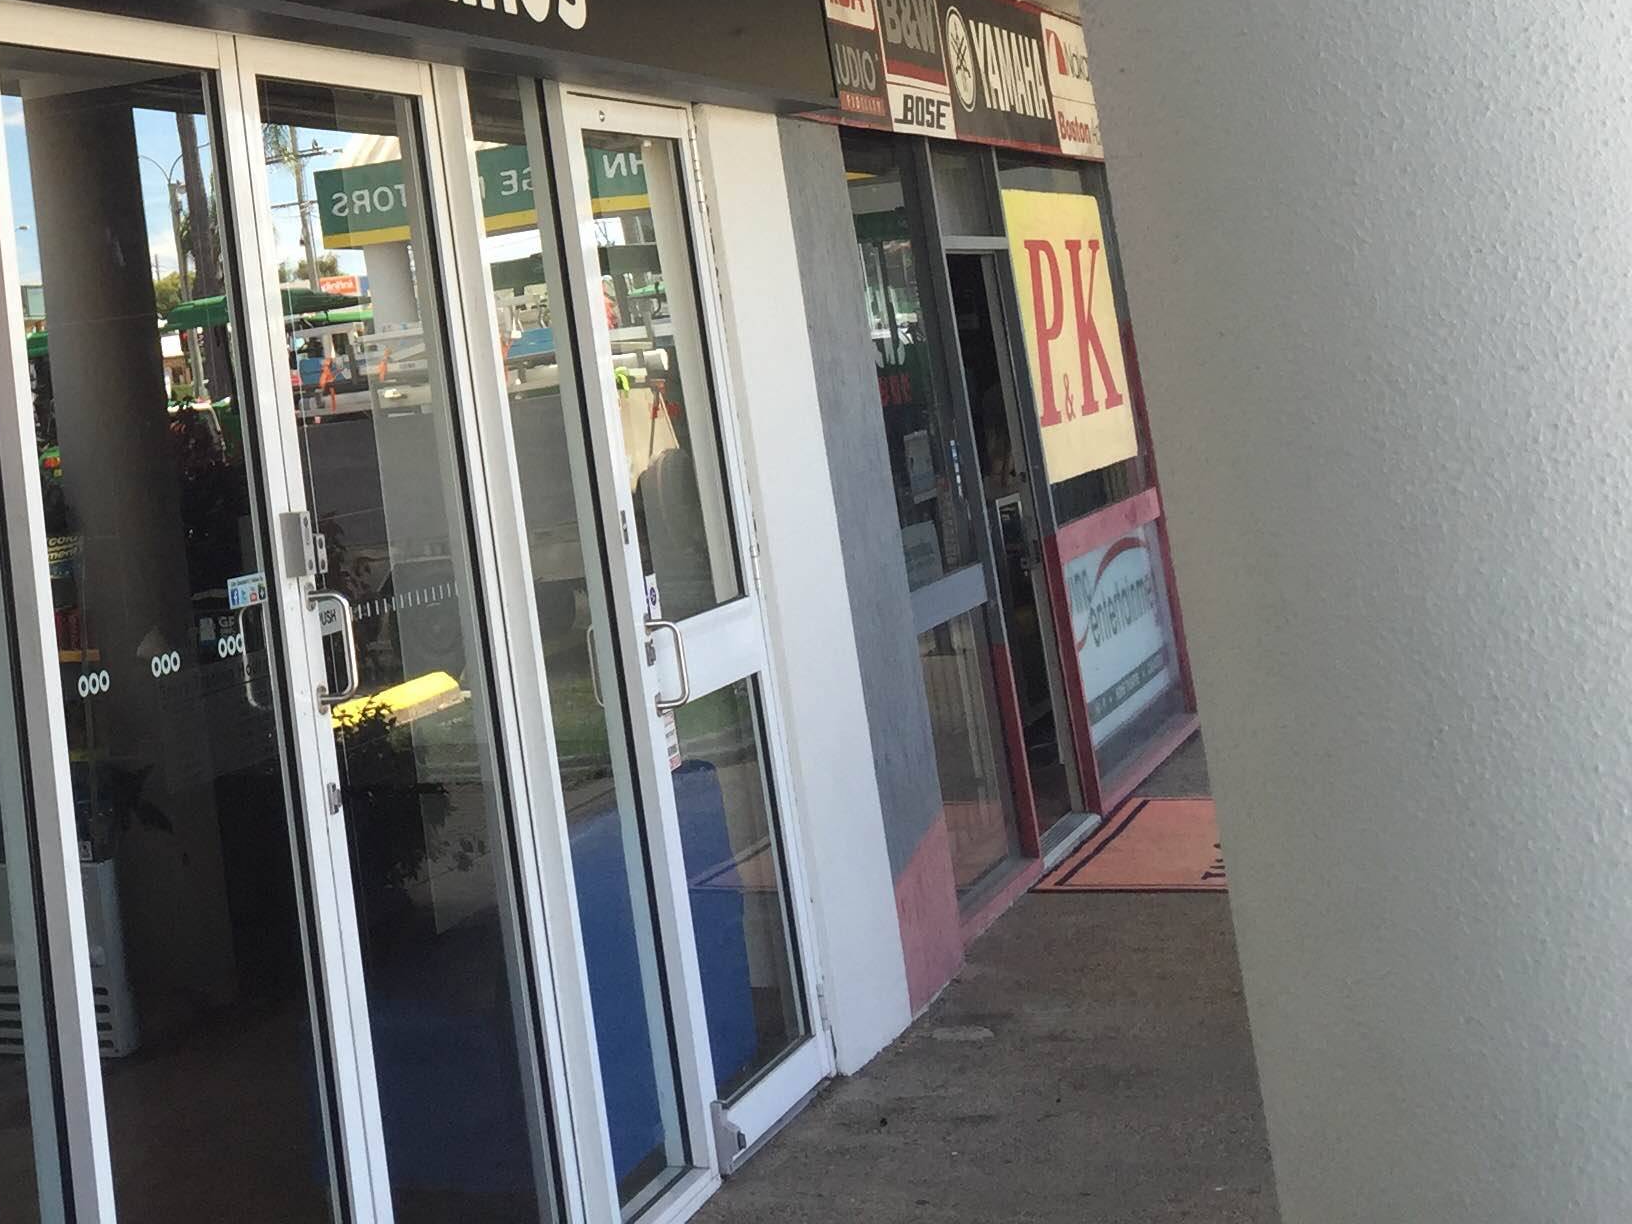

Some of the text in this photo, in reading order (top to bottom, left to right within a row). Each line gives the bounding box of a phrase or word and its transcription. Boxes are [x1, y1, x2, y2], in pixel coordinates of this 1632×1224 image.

[834, 43, 876, 91] UDIO
[969, 19, 1053, 120] YAMAHA
[894, 94, 951, 130] BOSE
[1057, 111, 1092, 145] Boston
[319, 608, 337, 627] USH
